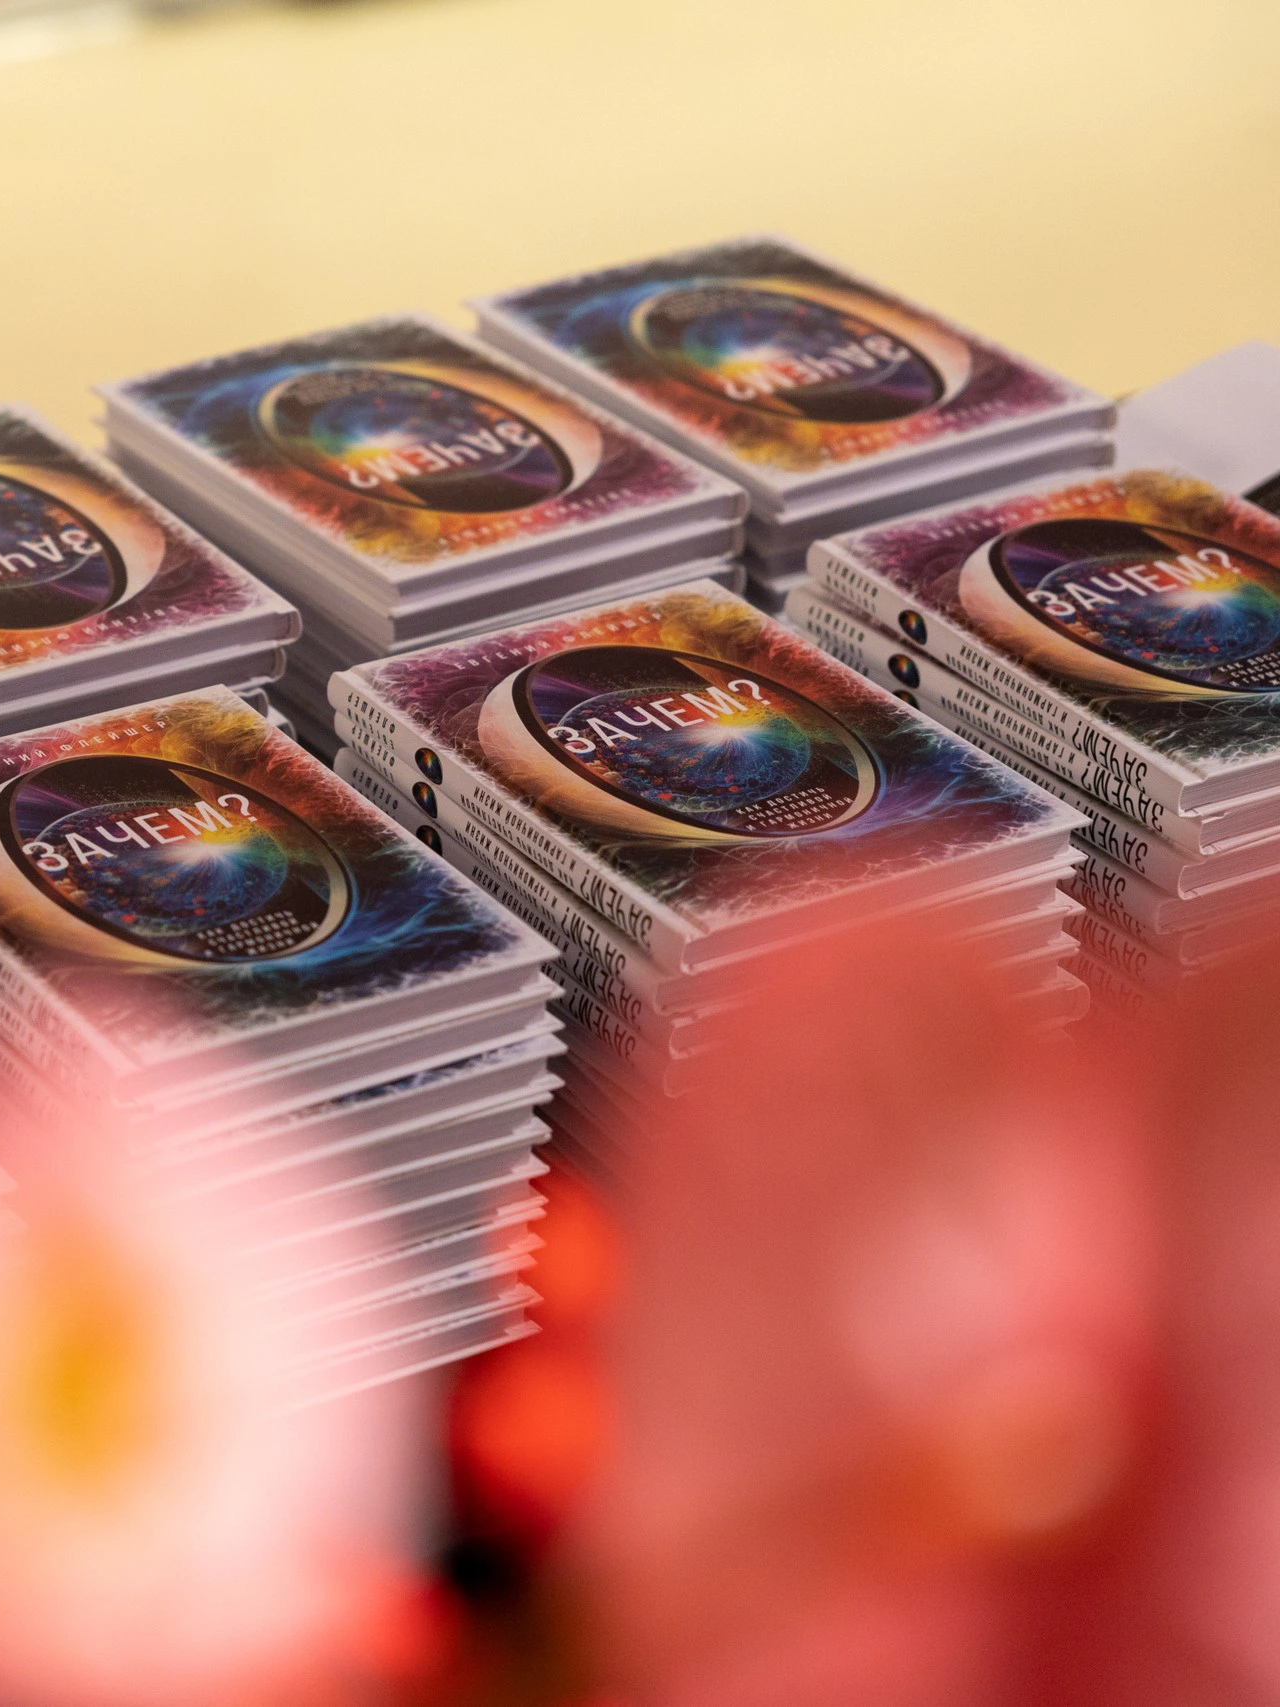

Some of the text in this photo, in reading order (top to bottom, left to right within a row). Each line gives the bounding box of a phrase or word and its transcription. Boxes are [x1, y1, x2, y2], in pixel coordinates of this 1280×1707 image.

[342, 419, 540, 489] ЗАЧЕМ?
[1026, 547, 1242, 618] ЗАЧЕМ?
[454, 640, 551, 671] ЕВГЕНИЙ
[60, 720, 167, 753] ФЛЕЙШЕР
[547, 678, 771, 755] ЗАЧЕМ?
[1072, 720, 1148, 794] ЗАЧЕМ?
[473, 786, 503, 816] ЖИЗНИ
[735, 787, 825, 815] КАК ДОСТИЧЬ
[748, 793, 832, 821] СЧАСТЛИВОЙ
[760, 796, 854, 827] ГАРМОНИЧНОЙ
[787, 812, 833, 829] ЖИЗНИ
[1081, 761, 1164, 833] ЗАЧЕМ?
[22, 794, 259, 873] ЗАЧЕМ?
[465, 820, 492, 852] ЖИЗНИ
[505, 810, 568, 865] ГАРМОНИЧНОЙ
[471, 865, 500, 895] ЖИЗНИ
[493, 846, 550, 902] ГАРМОНИЧНОЙ
[580, 869, 653, 949] ЗАЧЕМ?
[561, 906, 627, 984] ЗАЧЕМ?
[573, 951, 641, 1032] ЗАЧЕМ?
